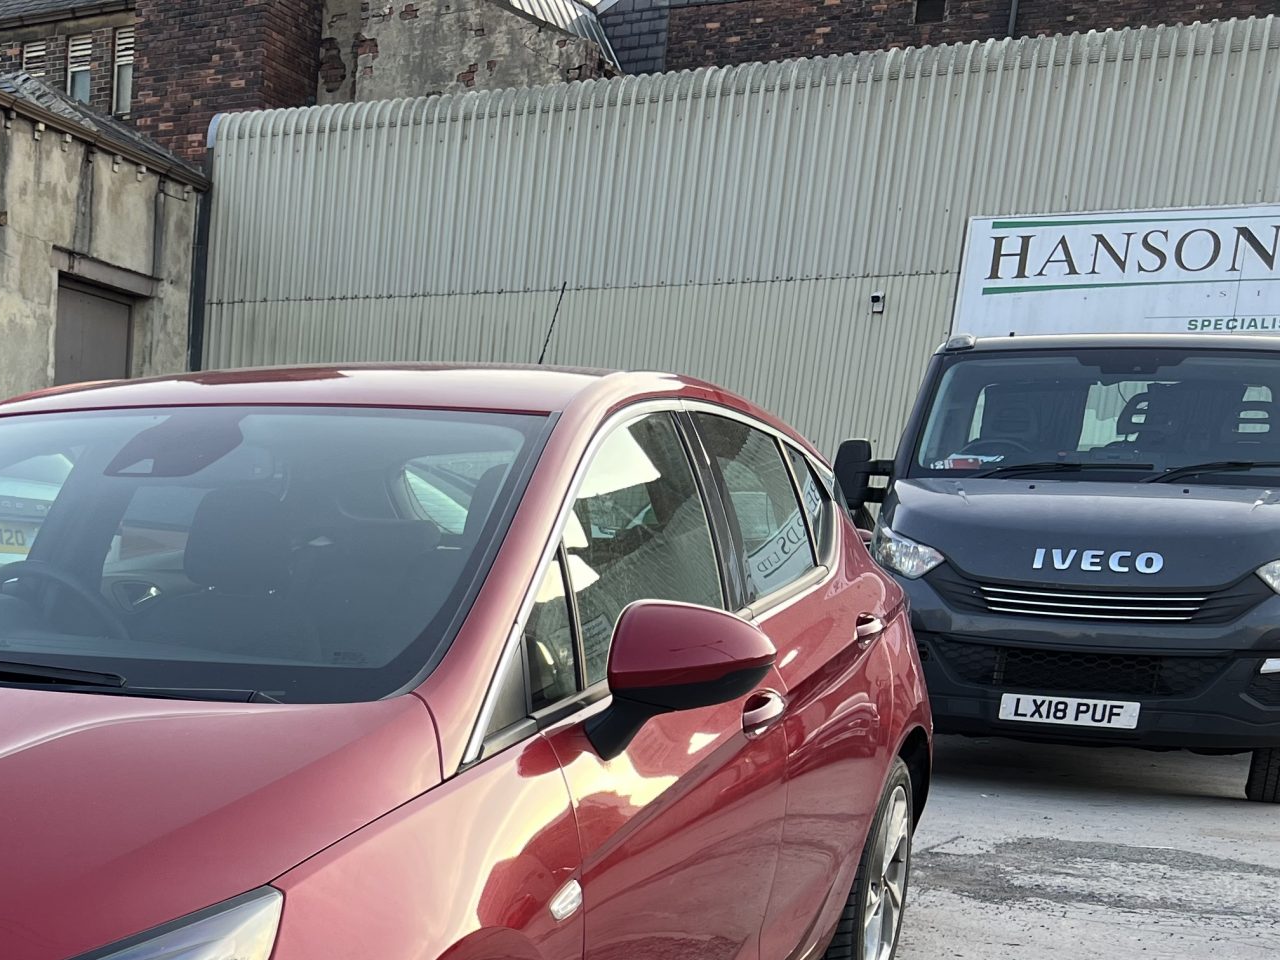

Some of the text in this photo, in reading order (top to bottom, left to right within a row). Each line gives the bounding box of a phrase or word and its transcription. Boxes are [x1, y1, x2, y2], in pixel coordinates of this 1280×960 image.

[984, 224, 1280, 281] HANSON
[1187, 317, 1280, 331] SPECIALI
[1032, 547, 1165, 574] IVECO
[1013, 697, 1124, 724] LX18 PUF
